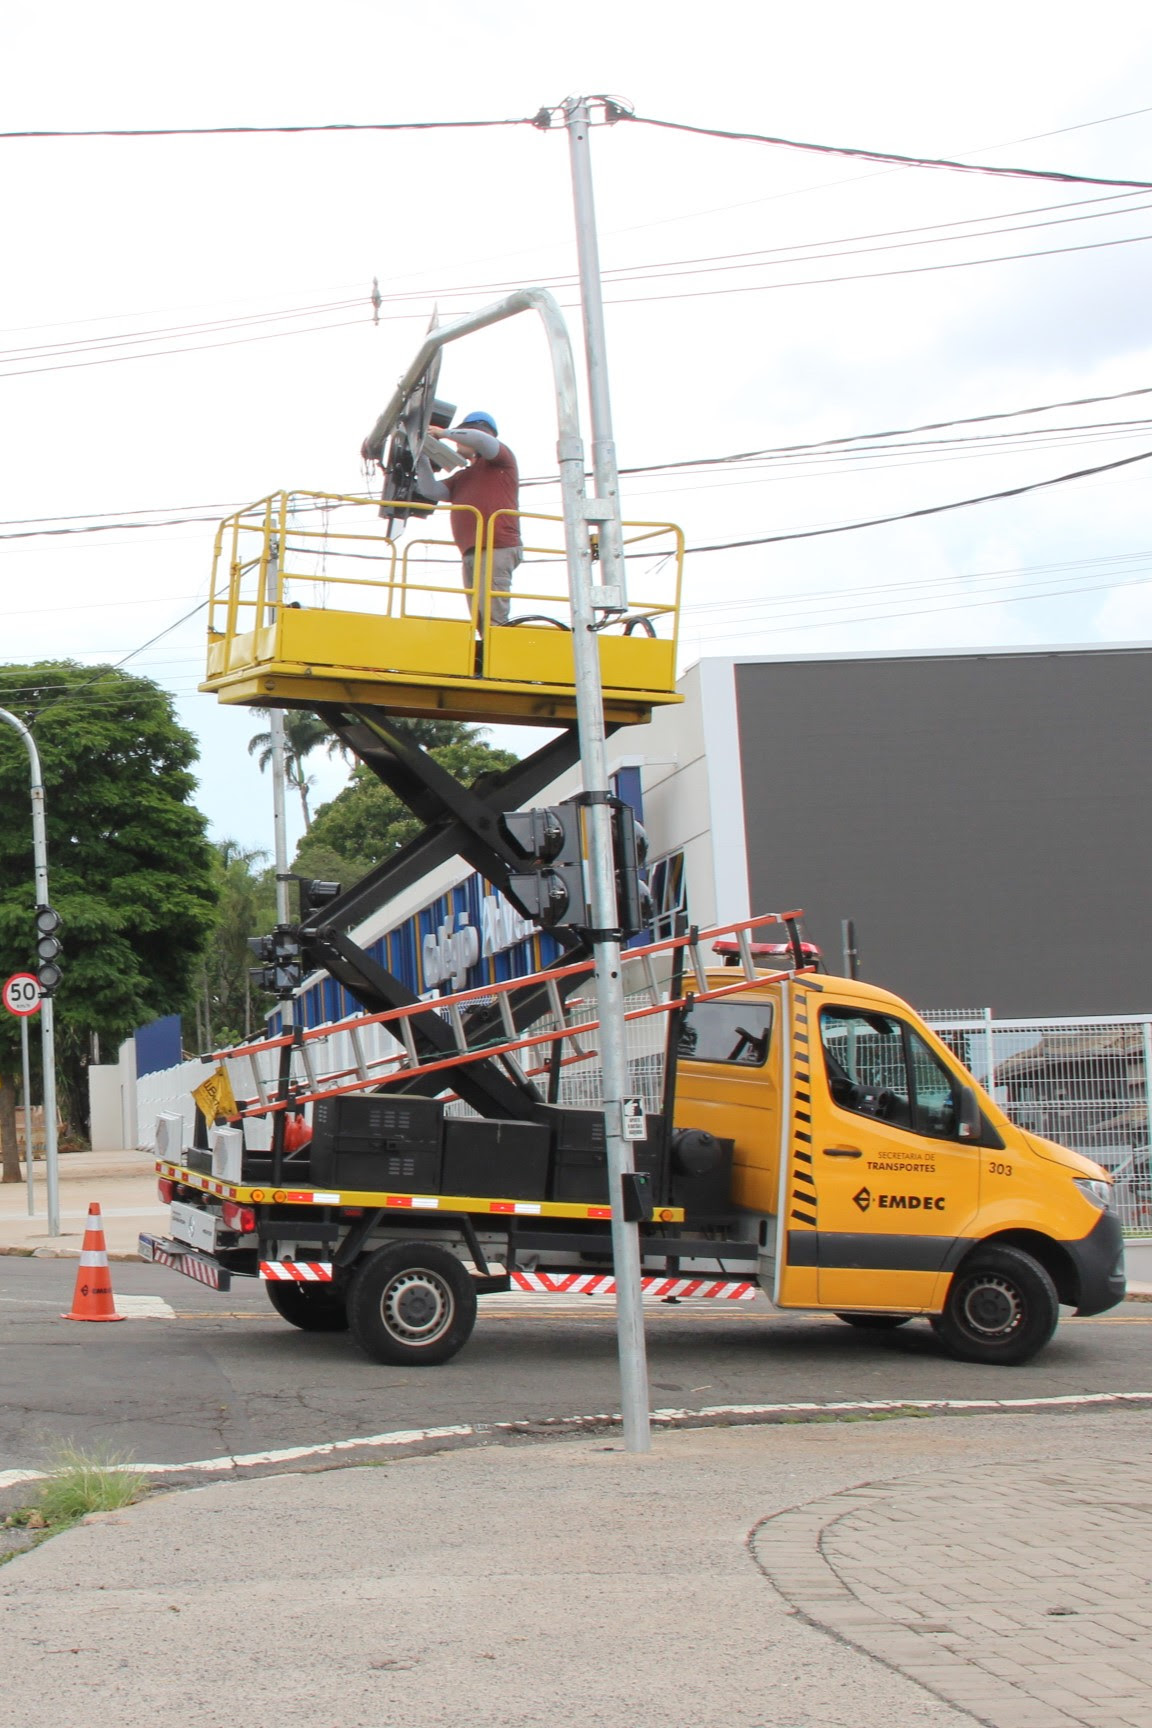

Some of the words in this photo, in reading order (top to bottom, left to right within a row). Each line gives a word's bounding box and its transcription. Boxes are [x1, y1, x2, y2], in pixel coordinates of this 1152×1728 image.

[11, 983, 35, 1001] 50
[877, 1151, 923, 1161] SECRETARIA
[924, 1153, 935, 1161] DE
[867, 1161, 936, 1173] TRANSPORTES
[988, 1161, 1013, 1177] 303
[878, 1194, 945, 1211] EMDEC
